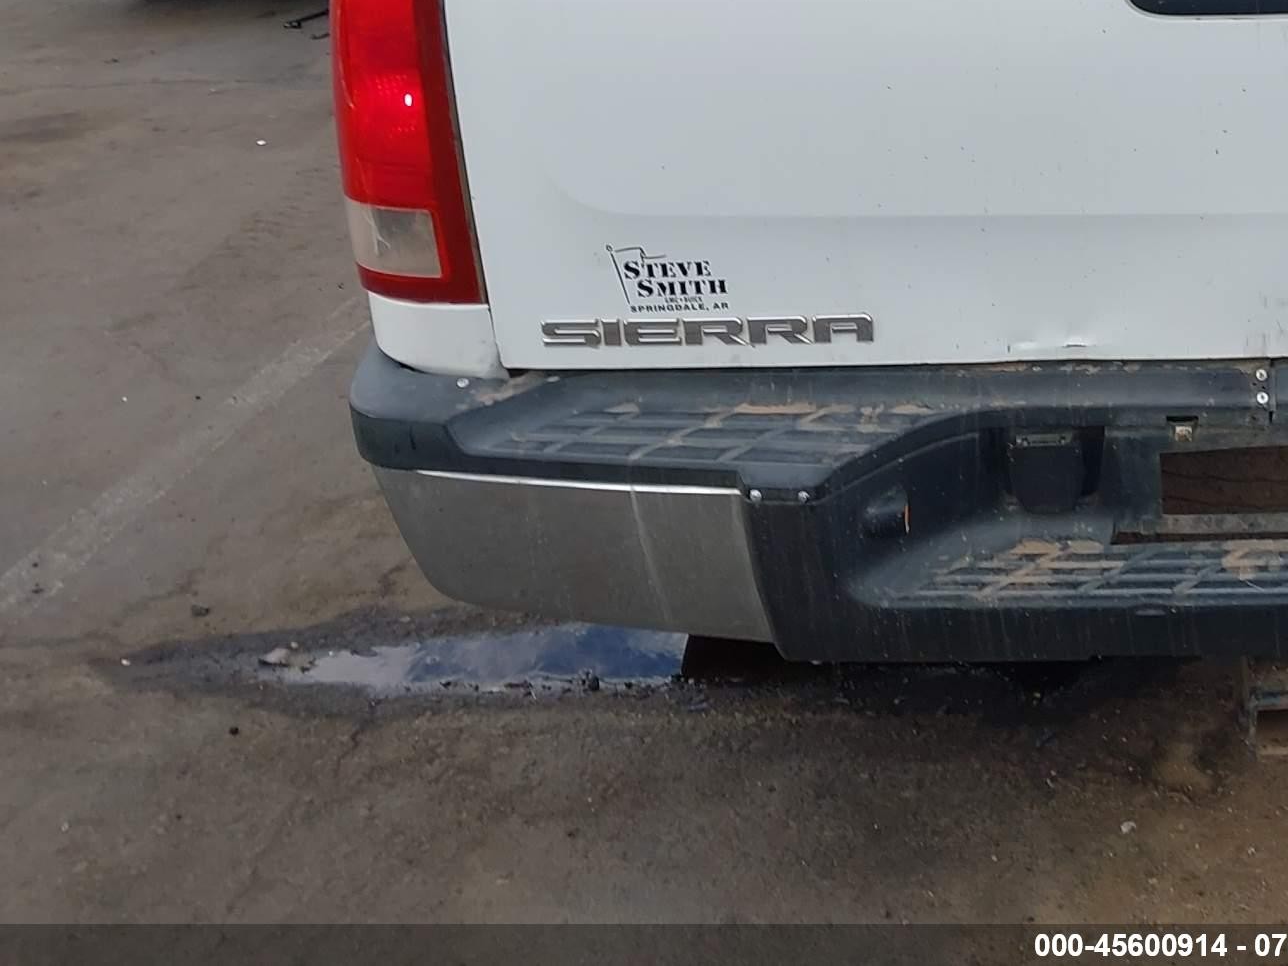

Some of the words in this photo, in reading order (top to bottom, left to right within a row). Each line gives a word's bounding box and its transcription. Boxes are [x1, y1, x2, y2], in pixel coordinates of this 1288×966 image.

[623, 259, 711, 279] STEVE
[637, 278, 728, 298] SMITH
[630, 303, 710, 313] SPRINGDALE,
[713, 302, 729, 310] AR
[541, 313, 875, 347] SIERRA
